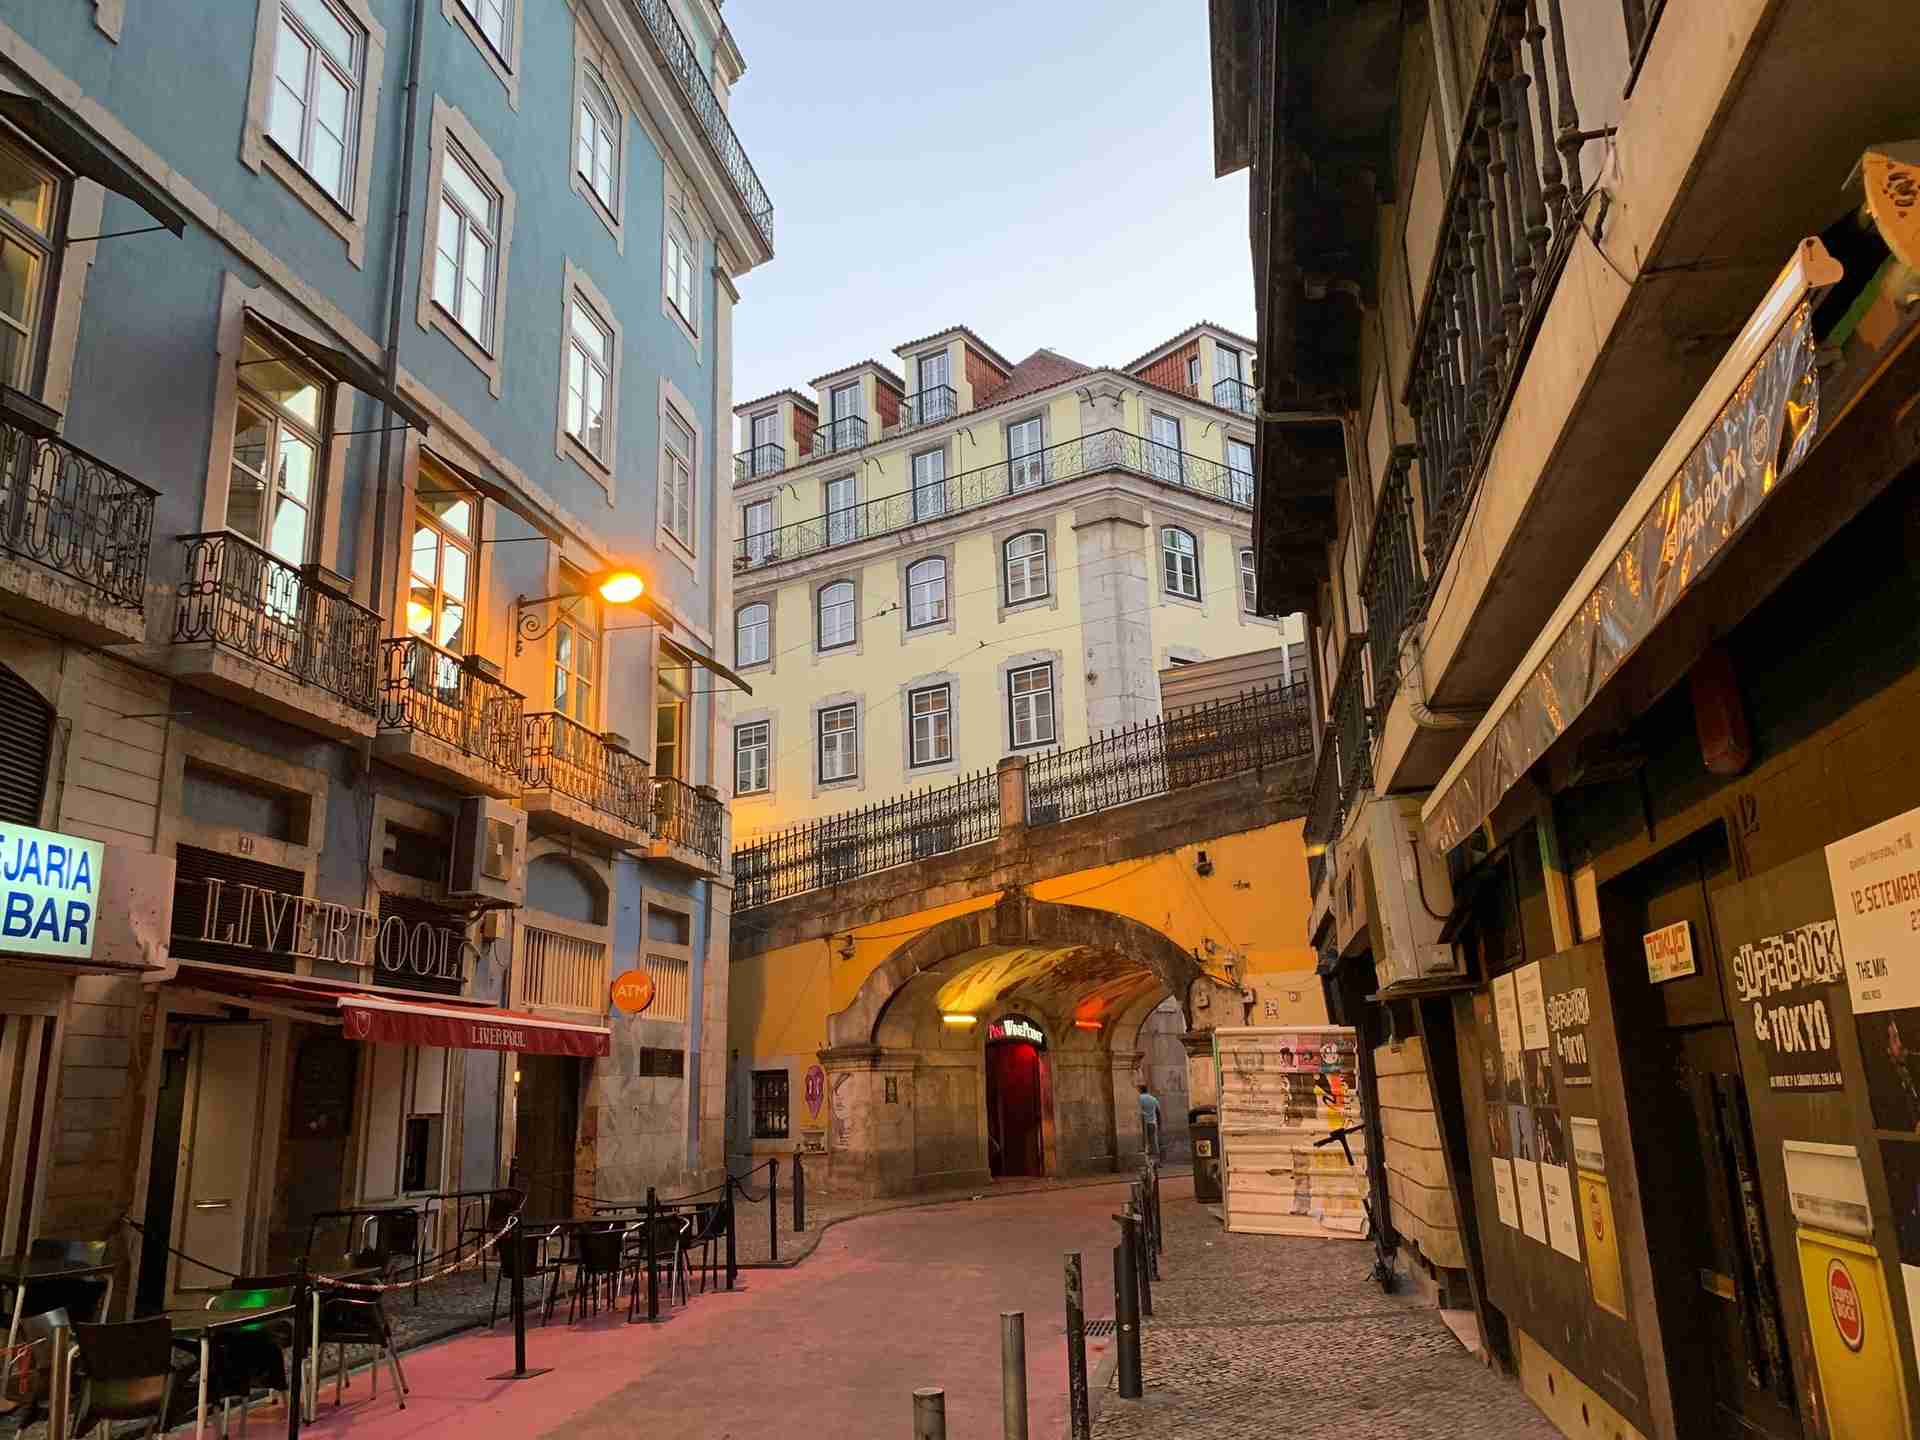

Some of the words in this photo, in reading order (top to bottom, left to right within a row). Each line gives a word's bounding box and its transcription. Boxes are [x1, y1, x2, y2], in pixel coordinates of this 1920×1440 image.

[2, 891, 90, 945] BAR
[1851, 889, 1865, 916] 12
[200, 877, 464, 980] LIVERPOOL
[614, 983, 650, 1001] ATM
[471, 1025, 526, 1048] LIVERPOOL
[1753, 1002, 1771, 1041] &
[1768, 1000, 1831, 1053] TOKYO
